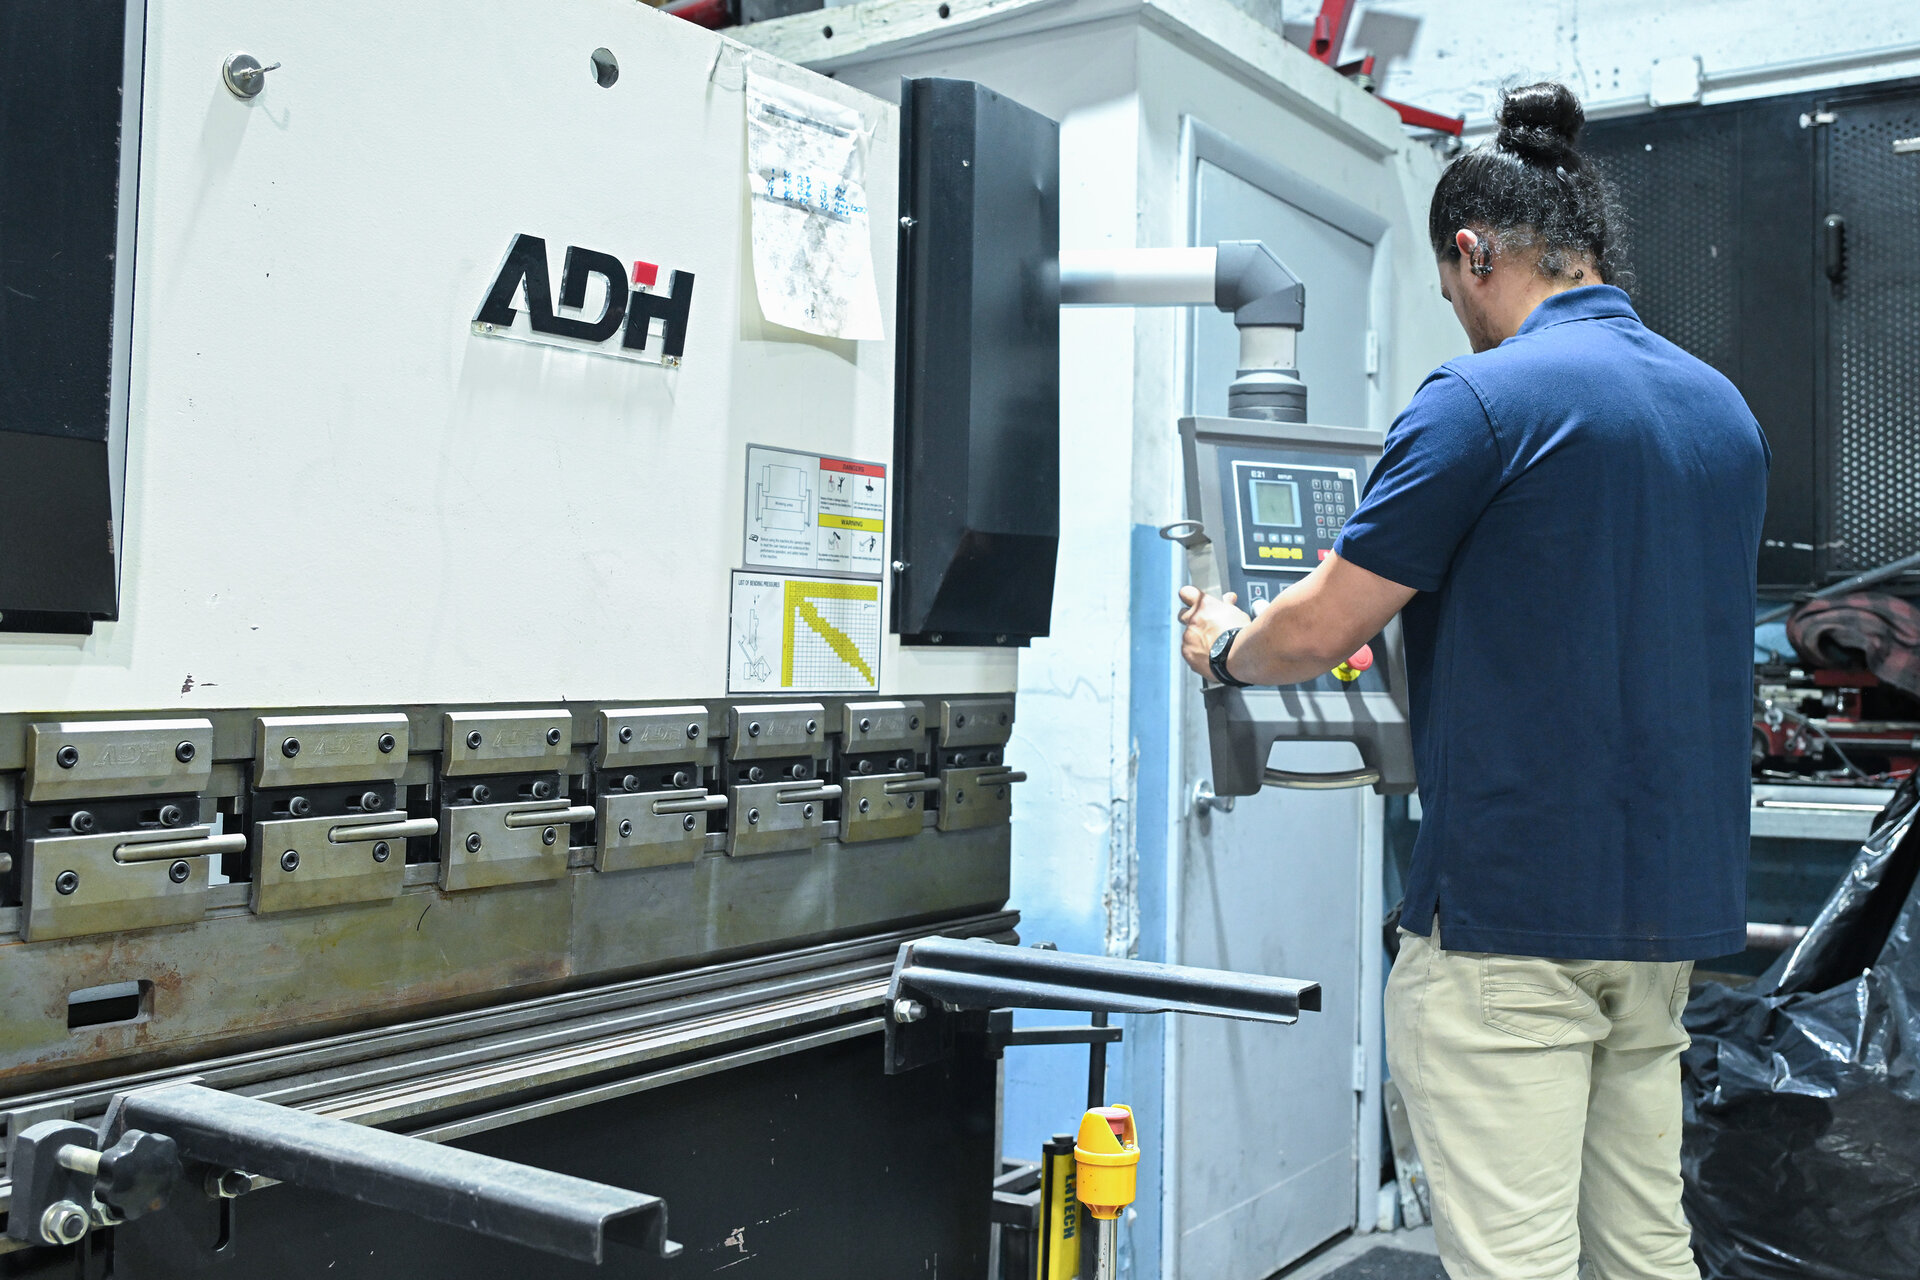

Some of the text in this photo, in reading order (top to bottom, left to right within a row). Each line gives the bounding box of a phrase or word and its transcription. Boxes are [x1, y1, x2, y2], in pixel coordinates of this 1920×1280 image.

[472, 233, 695, 358] ADH
[1251, 470, 1265, 478] E21
[841, 519, 863, 528] WARNING
